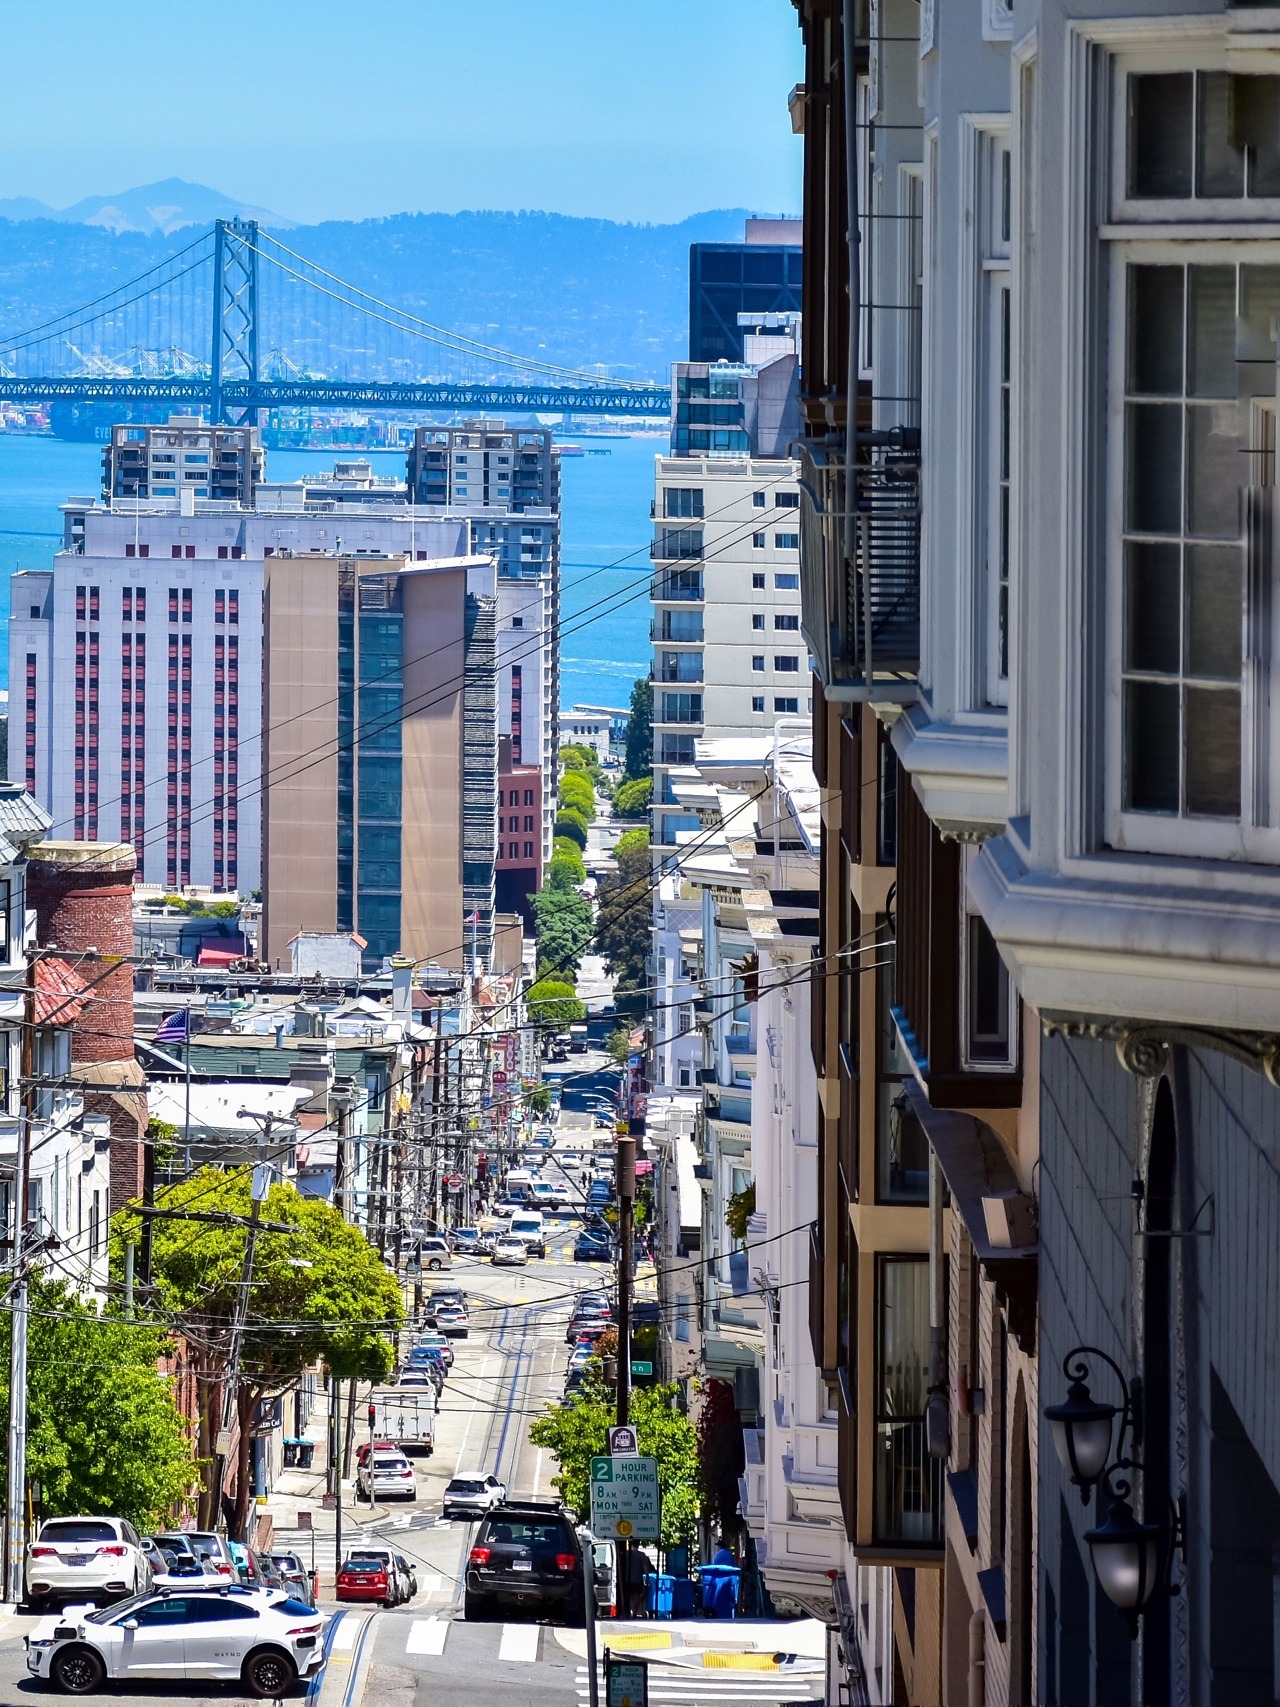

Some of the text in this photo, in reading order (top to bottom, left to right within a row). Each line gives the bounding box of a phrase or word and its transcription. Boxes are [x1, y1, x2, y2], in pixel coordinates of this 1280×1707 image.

[95, 427, 138, 440] EVEEN
[597, 1463, 647, 1479] 2 HOUR
[615, 1474, 655, 1482] PARKING
[597, 1486, 604, 1498] 8
[632, 1486, 639, 1498] 9
[597, 1502, 618, 1510] MON
[639, 1502, 653, 1511] SAT
[621, 1522, 628, 1535] C
[612, 1667, 619, 1676] 2
